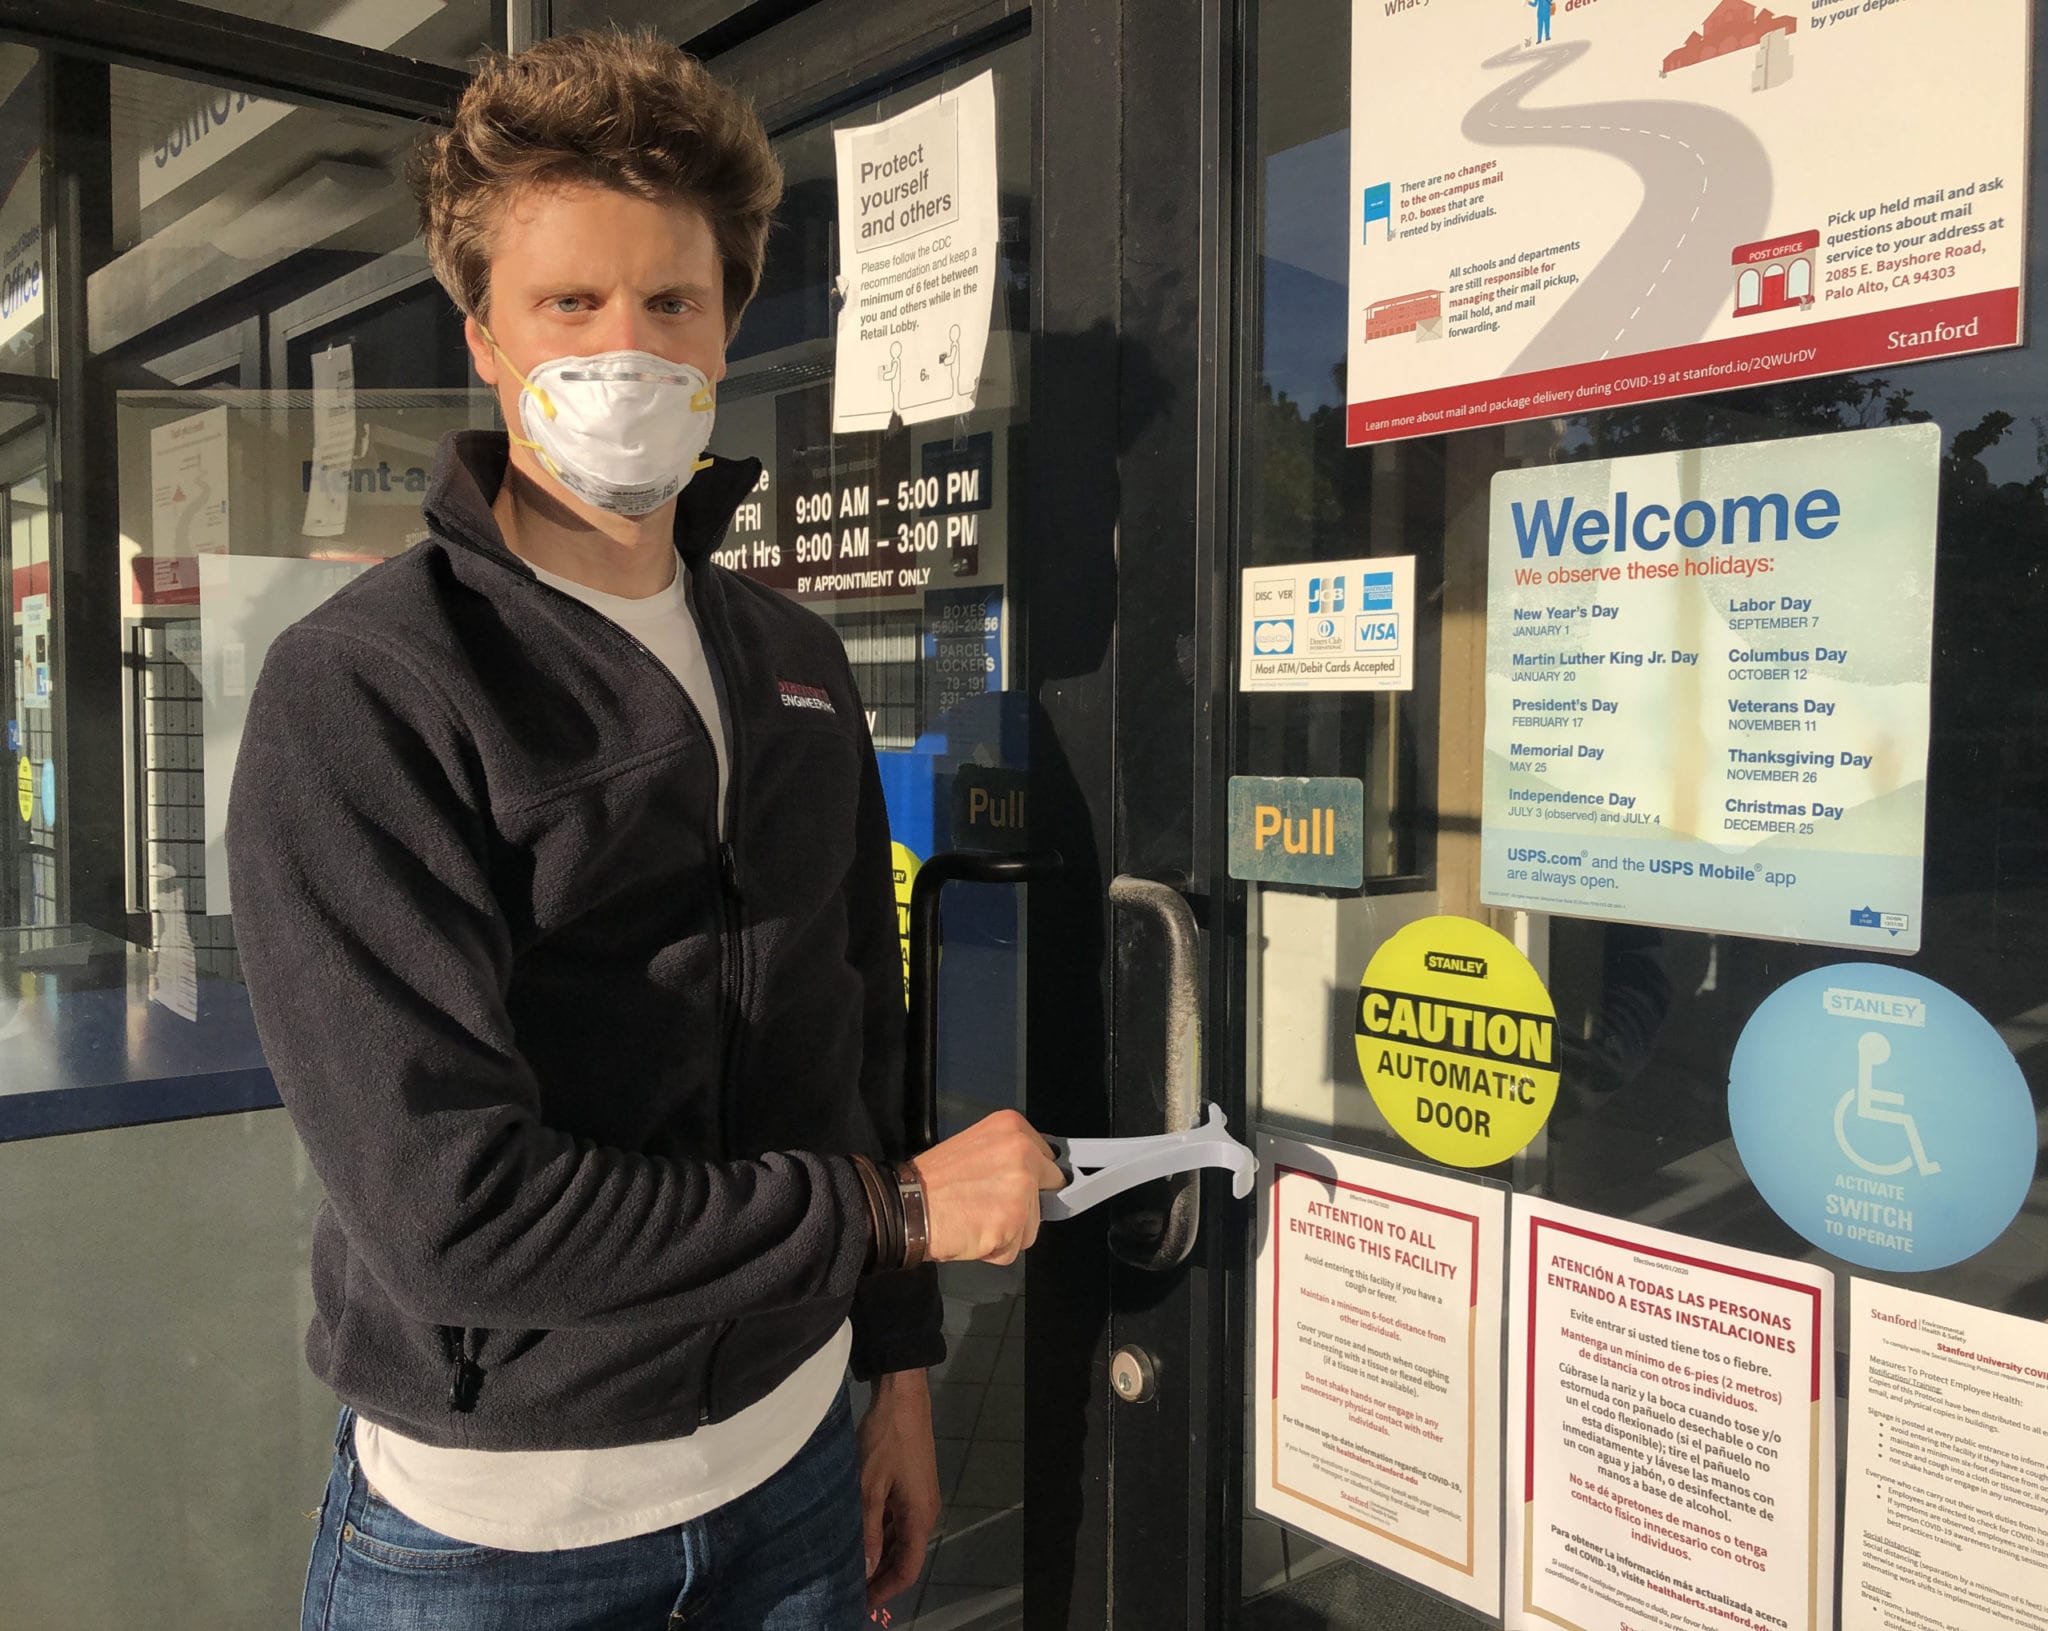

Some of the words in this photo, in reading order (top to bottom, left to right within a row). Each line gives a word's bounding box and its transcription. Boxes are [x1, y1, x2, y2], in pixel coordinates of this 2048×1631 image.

[861, 143, 923, 183] Protect
[1400, 180, 1426, 192] There
[1427, 175, 1442, 186] are
[1443, 171, 1456, 181] no
[1457, 159, 1496, 177] changes
[860, 169, 928, 215] yourself
[1828, 210, 1855, 226] Pick
[1859, 207, 1876, 220] up
[1880, 196, 1910, 214] held
[1913, 189, 1944, 207] mail
[1947, 182, 1974, 199] and
[1978, 176, 2003, 193] ask
[861, 210, 894, 238] and
[900, 194, 951, 227] others
[1826, 223, 1892, 247] questions
[1895, 211, 1937, 230] about
[1940, 202, 1972, 220] mail
[861, 259, 890, 274] Please
[892, 251, 916, 265] follow
[917, 245, 930, 257] the
[931, 235, 951, 252] CDC
[1748, 248, 1771, 261] POST
[1772, 241, 1802, 256] OFFICE
[1826, 245, 1873, 263] service
[1875, 242, 1890, 253] to
[1893, 234, 1926, 253] your
[1928, 222, 1985, 242] address
[1988, 217, 2004, 230] at
[860, 263, 930, 290] recommendation
[932, 255, 947, 270] and
[949, 249, 970, 264] keep
[971, 247, 977, 256] a
[1449, 266, 1460, 278] All
[1462, 259, 1496, 275] schools
[1498, 253, 1516, 267] and
[1518, 241, 1580, 262] departments
[1825, 265, 1857, 282] 2085
[1860, 263, 1872, 275] E.
[1876, 251, 1941, 272] Bayshore
[1945, 239, 1986, 258] Road,
[860, 289, 903, 307] minimum
[905, 283, 914, 296] of
[915, 281, 921, 293] 6
[923, 275, 939, 290] feet
[941, 264, 978, 284] between
[1825, 285, 1853, 300] Palo
[1856, 281, 1888, 295] Alto,
[1892, 274, 1910, 287] CA
[1913, 265, 1955, 284] 94303
[860, 312, 877, 326] you
[879, 305, 897, 320] and
[899, 299, 927, 315] others
[928, 290, 950, 306] while
[953, 287, 960, 298] in
[963, 282, 977, 295] the
[860, 324, 887, 340] Retail
[890, 319, 919, 335] Lobby.
[1887, 316, 1978, 349] Stanford
[1614, 374, 1666, 392] COVID-19
[1668, 372, 1680, 384] at
[1682, 348, 1816, 380] stanford.io/2QWUrDV
[796, 492, 832, 524] 9:00
[840, 486, 870, 518] AM
[898, 478, 938, 511] 5:00
[947, 469, 980, 505] PM
[735, 504, 761, 532] FRI
[1510, 488, 1841, 558] Welcome
[753, 540, 782, 570] Hrs
[796, 532, 832, 564] 9:00
[840, 526, 870, 559] AM
[898, 523, 938, 554] 3:00
[947, 514, 979, 548] PM
[798, 576, 812, 593] BY
[814, 570, 894, 592] APPOINTMENT
[898, 568, 931, 587] ONLY
[1514, 568, 1542, 585] We
[1547, 566, 1620, 584] observe
[1626, 561, 1679, 579] these
[1685, 555, 1774, 577] holidays:
[943, 603, 986, 619] BOXES
[1309, 589, 1344, 602] JCB
[1514, 608, 1542, 620] New
[1546, 605, 1587, 618] Year's
[1591, 604, 1619, 619] Day
[1729, 598, 1776, 612] Labor
[1780, 596, 1812, 612] Day
[1360, 622, 1396, 641] VISA
[1512, 624, 1562, 636] JANUARY
[1564, 625, 1569, 634] 1
[1728, 616, 1808, 630] SEPTEMBER
[1811, 616, 1819, 627] 7
[936, 657, 996, 672] LOCKERS
[940, 644, 989, 657] PARCEL
[1255, 664, 1275, 674] Most
[1276, 662, 1322, 675] ATM/Debit
[1325, 661, 1350, 672] Cards
[1353, 658, 1395, 674] Accepted
[970, 788, 1024, 830] Pull
[1724, 818, 1795, 833] DECEMBER
[1798, 823, 1814, 834] 25
[1725, 798, 1806, 815] Christmas
[1811, 802, 1844, 820] Day
[1254, 805, 1335, 856] Pull
[1507, 869, 1527, 880] are
[1531, 868, 1576, 887] always
[1580, 875, 1618, 889] open.
[1428, 956, 1484, 974] STANLEY
[1830, 994, 1918, 1019] STANLEY
[1362, 992, 1552, 1064] CAUTION
[1378, 1050, 1536, 1106] AUTOMATIC
[1416, 1096, 1491, 1138] DOOR
[1834, 1174, 1904, 1202] ACTIVATE
[1307, 1201, 1383, 1234] ATTENTION
[1387, 1222, 1406, 1240] TO
[1409, 1229, 1436, 1249] ALL
[1825, 1193, 1913, 1232] SWITCH
[1290, 1218, 1355, 1249] ENTERING
[1358, 1238, 1390, 1260] THIS
[1395, 1248, 1457, 1280] FACILITY
[1824, 1219, 1843, 1236] TO
[1847, 1224, 1914, 1252] OPERATE
[1551, 1255, 1613, 1283] ATENCIÓN
[1616, 1274, 1625, 1287] A
[1628, 1277, 1674, 1300] TODAS
[1678, 1290, 1704, 1308] LAS
[1709, 1298, 1791, 1330] PERSONAS
[1548, 1273, 1615, 1303] ENTRANDO
[1618, 1295, 1626, 1308] A
[1630, 1298, 1672, 1320] ESTAS
[1676, 1310, 1796, 1353] INSTALACIONES
[1871, 1308, 1917, 1330] Stanford
[1570, 1308, 1594, 1324] Evite
[1595, 1319, 1626, 1334] entrar
[1627, 1328, 1636, 1338] si
[1638, 1332, 1668, 1348] usted
[1670, 1340, 1700, 1356] tiene
[1702, 1348, 1720, 1362] tos
[1723, 1356, 1730, 1364] o
[1733, 1356, 1771, 1376] fiebre.
[1937, 1342, 1974, 1359] Stanford
[1976, 1353, 2022, 1374] University
